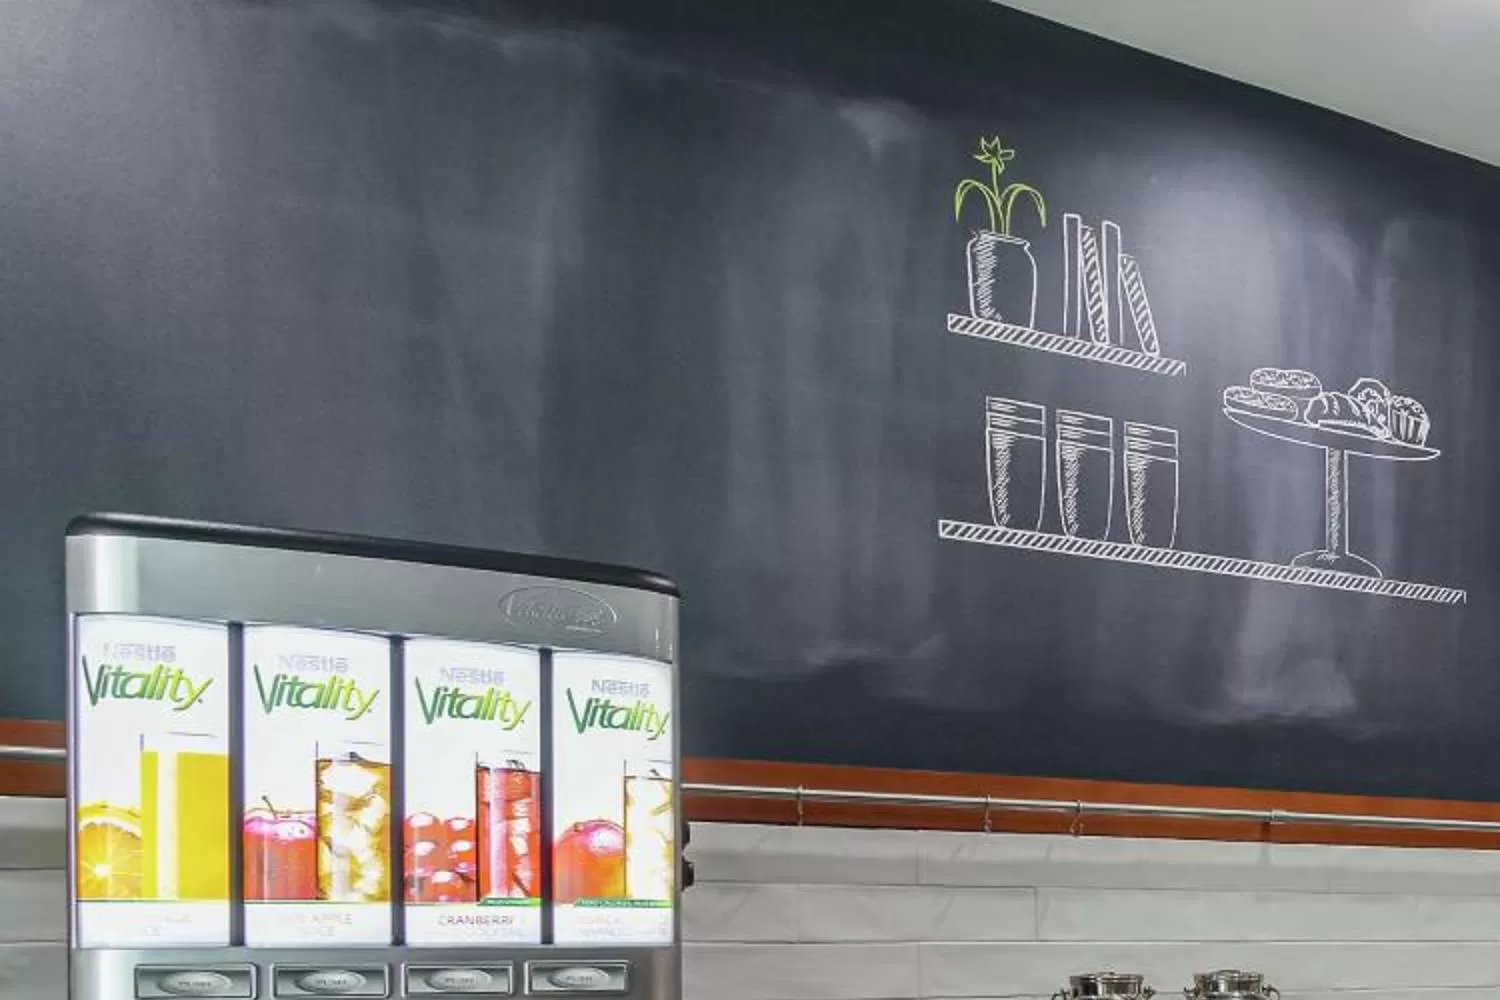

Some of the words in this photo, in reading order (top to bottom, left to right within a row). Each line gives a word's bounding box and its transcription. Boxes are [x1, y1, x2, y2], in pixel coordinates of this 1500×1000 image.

[82, 655, 215, 712] Vitality
[254, 663, 381, 722] Vitality
[415, 675, 533, 731] Vitality
[566, 687, 670, 740] Vitality
